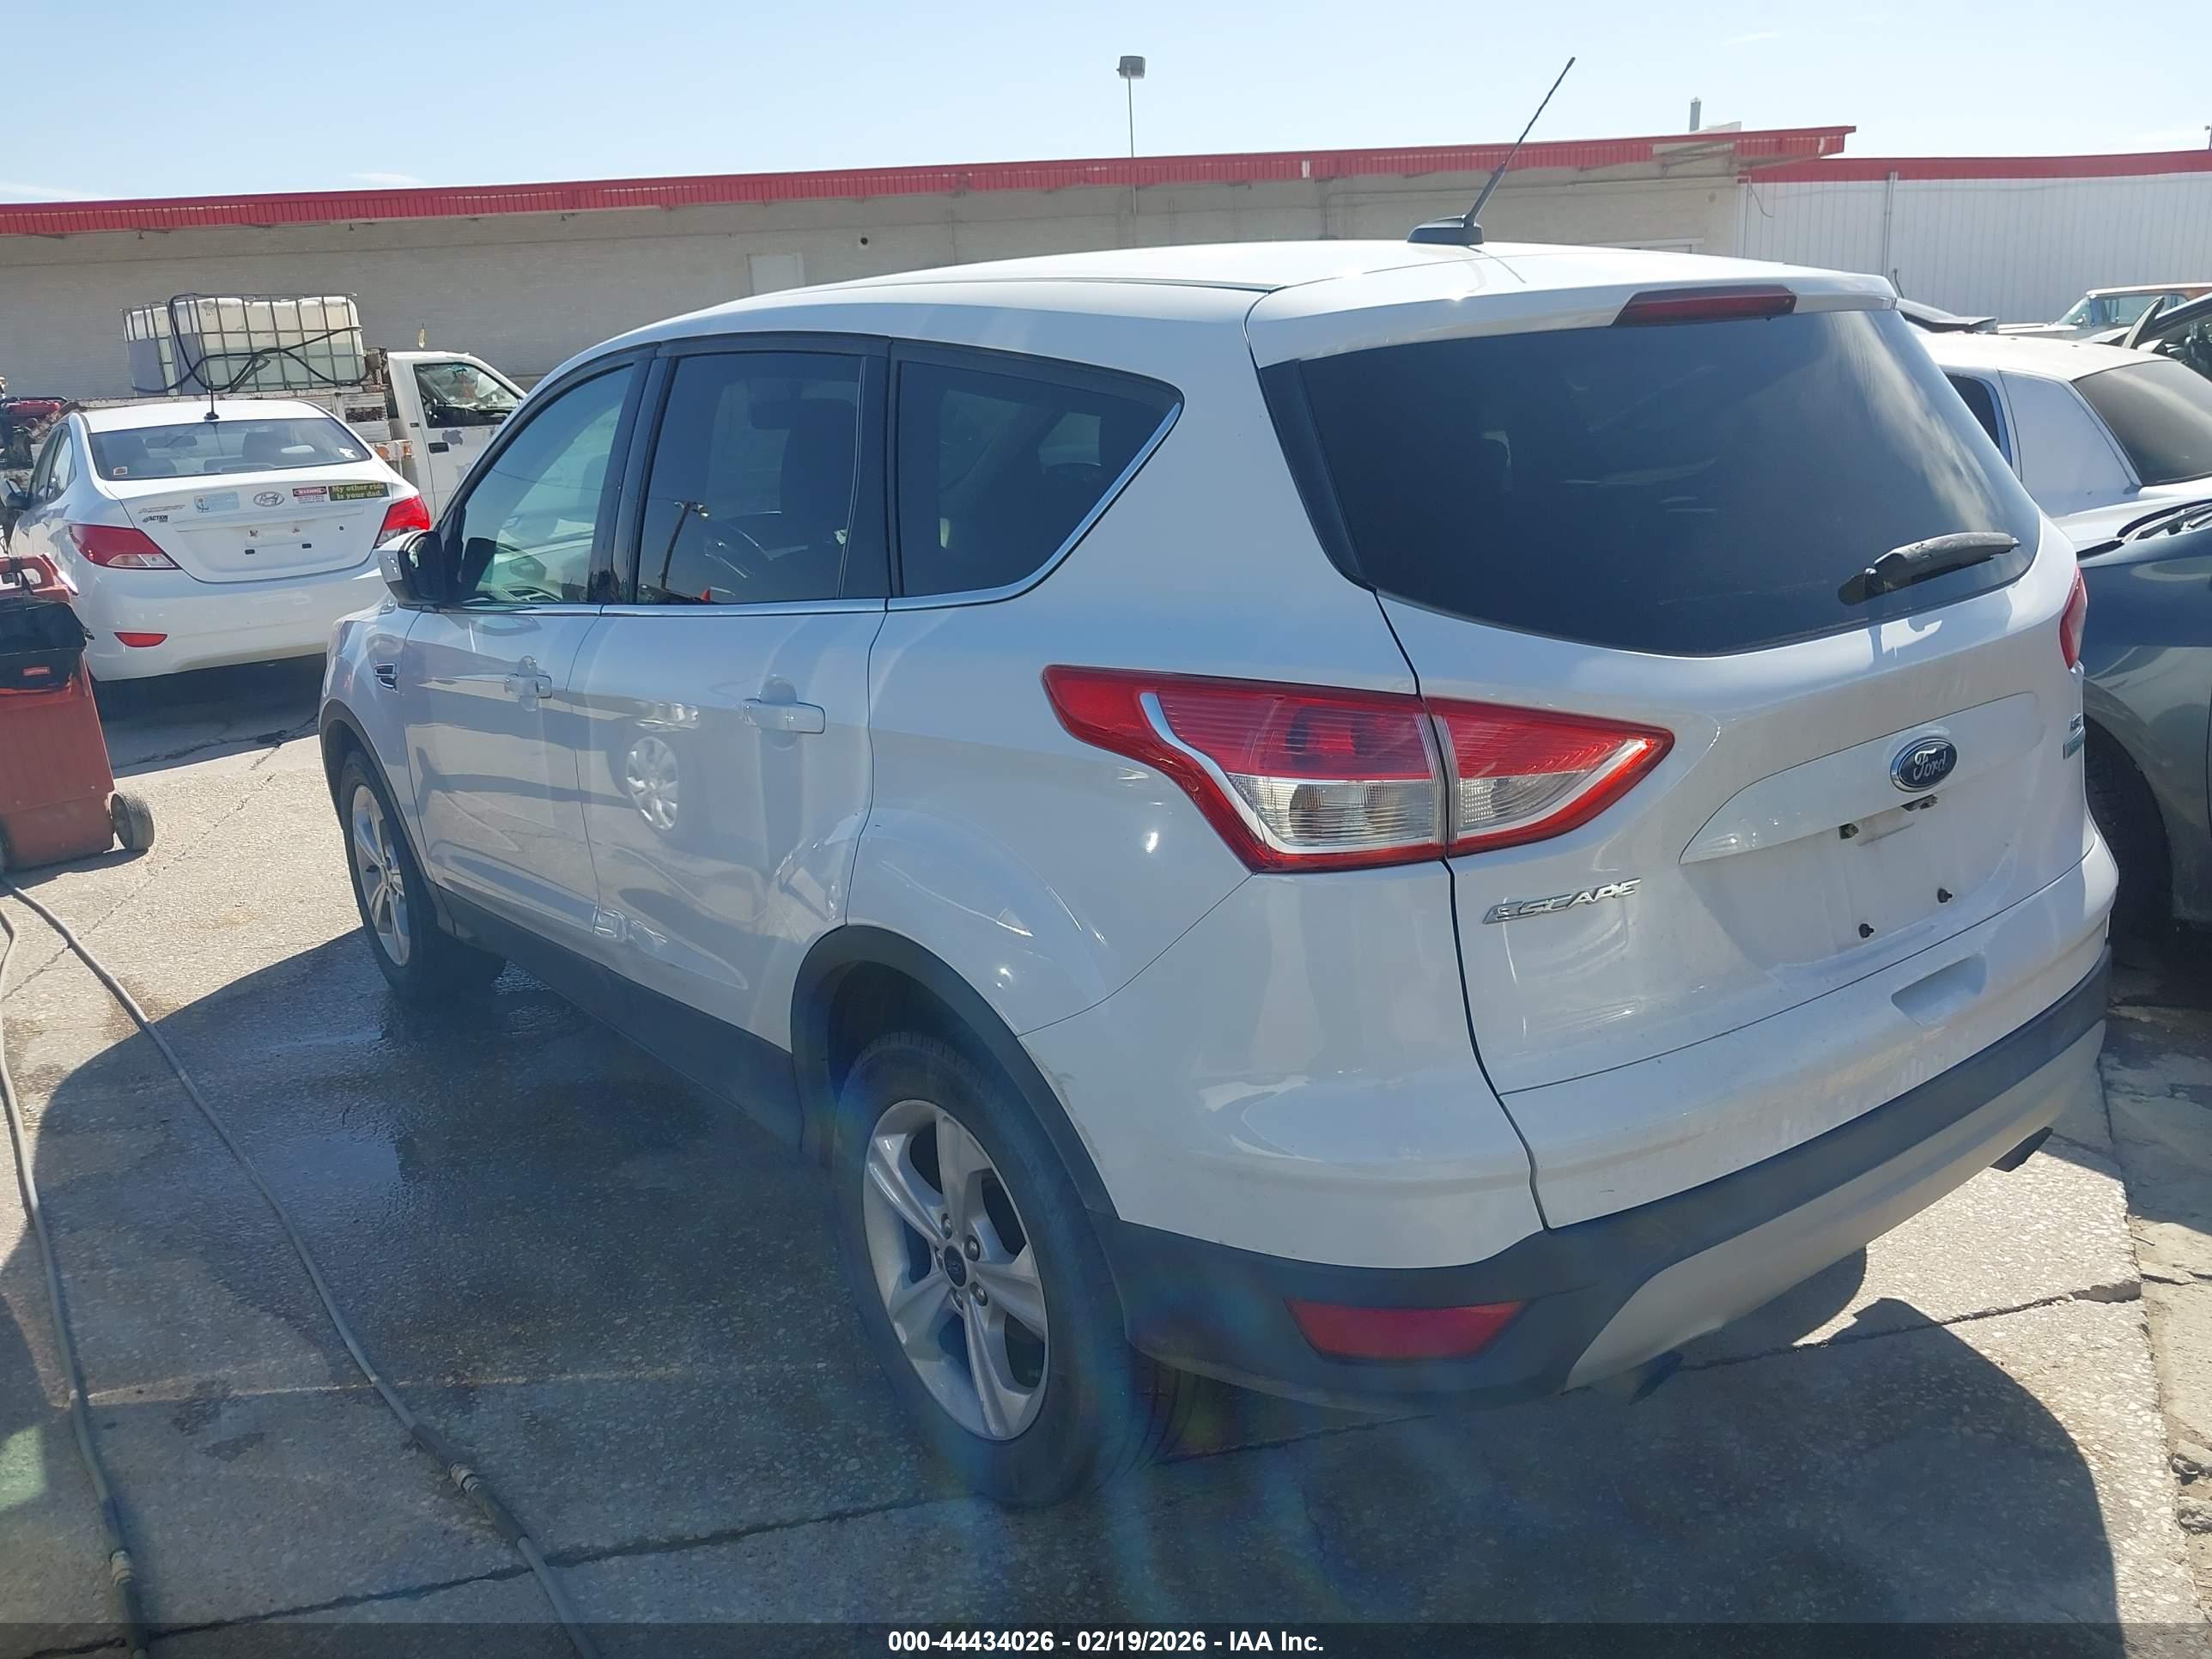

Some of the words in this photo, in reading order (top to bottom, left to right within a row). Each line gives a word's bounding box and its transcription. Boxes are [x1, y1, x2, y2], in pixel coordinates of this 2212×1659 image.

[331, 485, 344, 494] My
[346, 483, 368, 492] other
[369, 482, 385, 490] ride
[346, 492, 365, 501] your
[1913, 748, 1946, 781] Ford
[1482, 877, 1643, 925] ESCAPE
